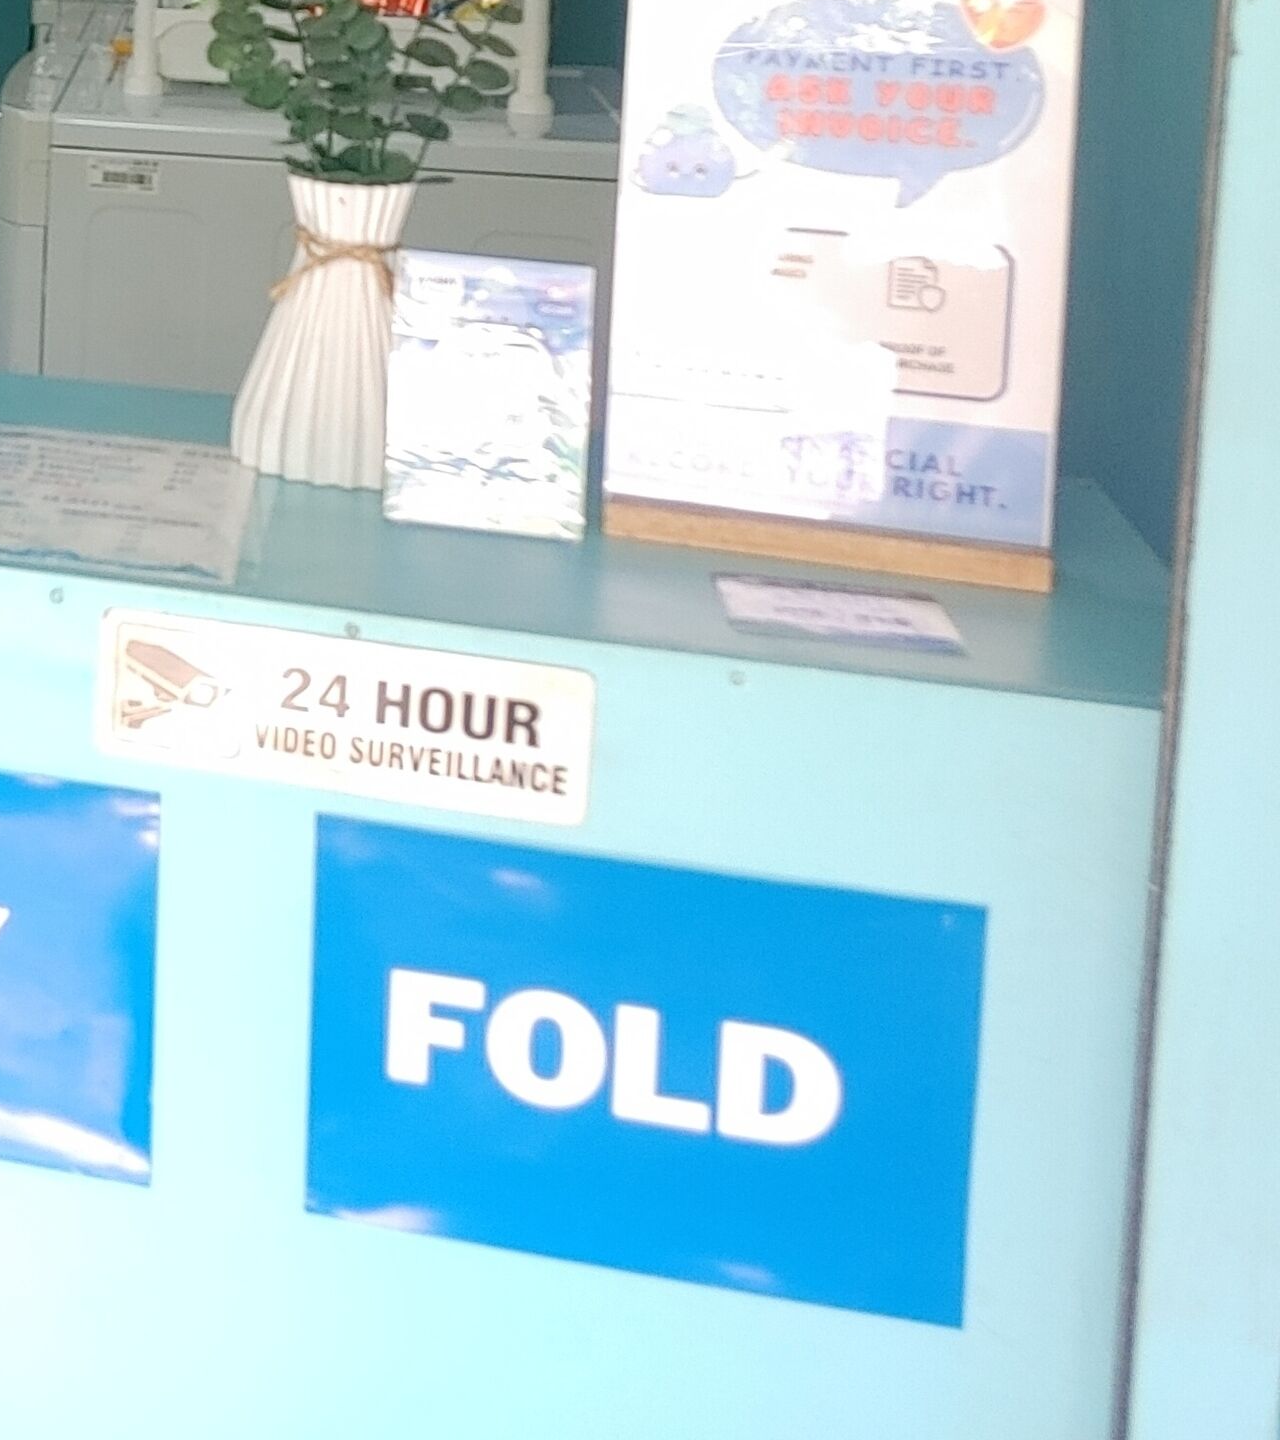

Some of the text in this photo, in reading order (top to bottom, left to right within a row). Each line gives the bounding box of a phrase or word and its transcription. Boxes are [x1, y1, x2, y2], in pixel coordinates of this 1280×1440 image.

[873, 79, 997, 116] YOUR
[280, 667, 542, 748] 24 HOUR
[254, 723, 569, 797] VIDEO SURVEILLANCE
[385, 966, 843, 1147] FOLD
